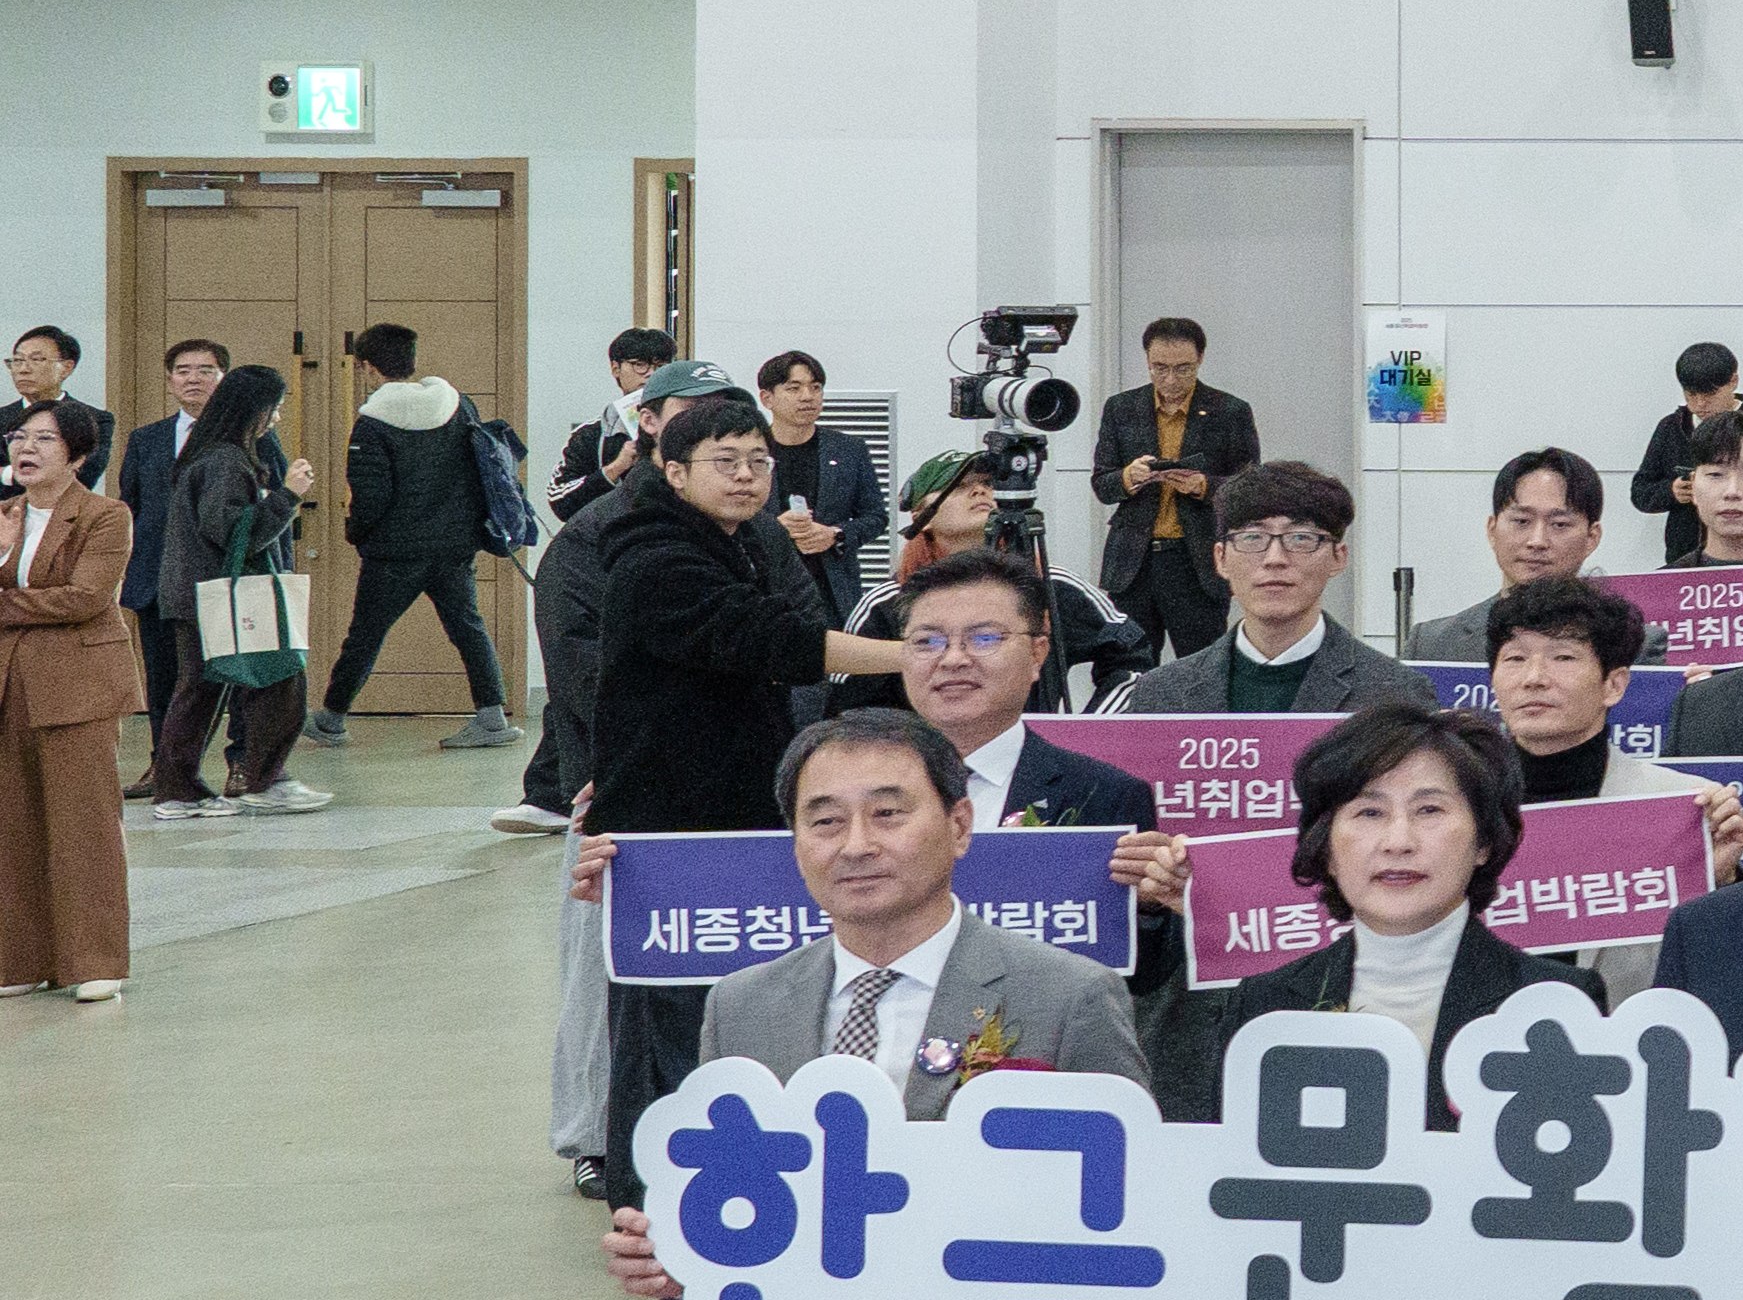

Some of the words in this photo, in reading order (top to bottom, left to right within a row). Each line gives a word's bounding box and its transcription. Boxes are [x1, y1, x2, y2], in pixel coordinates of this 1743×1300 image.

[1390, 350, 1422, 367] VIP
[1379, 368, 1432, 387] 대기실
[1179, 737, 1261, 770] 2025
